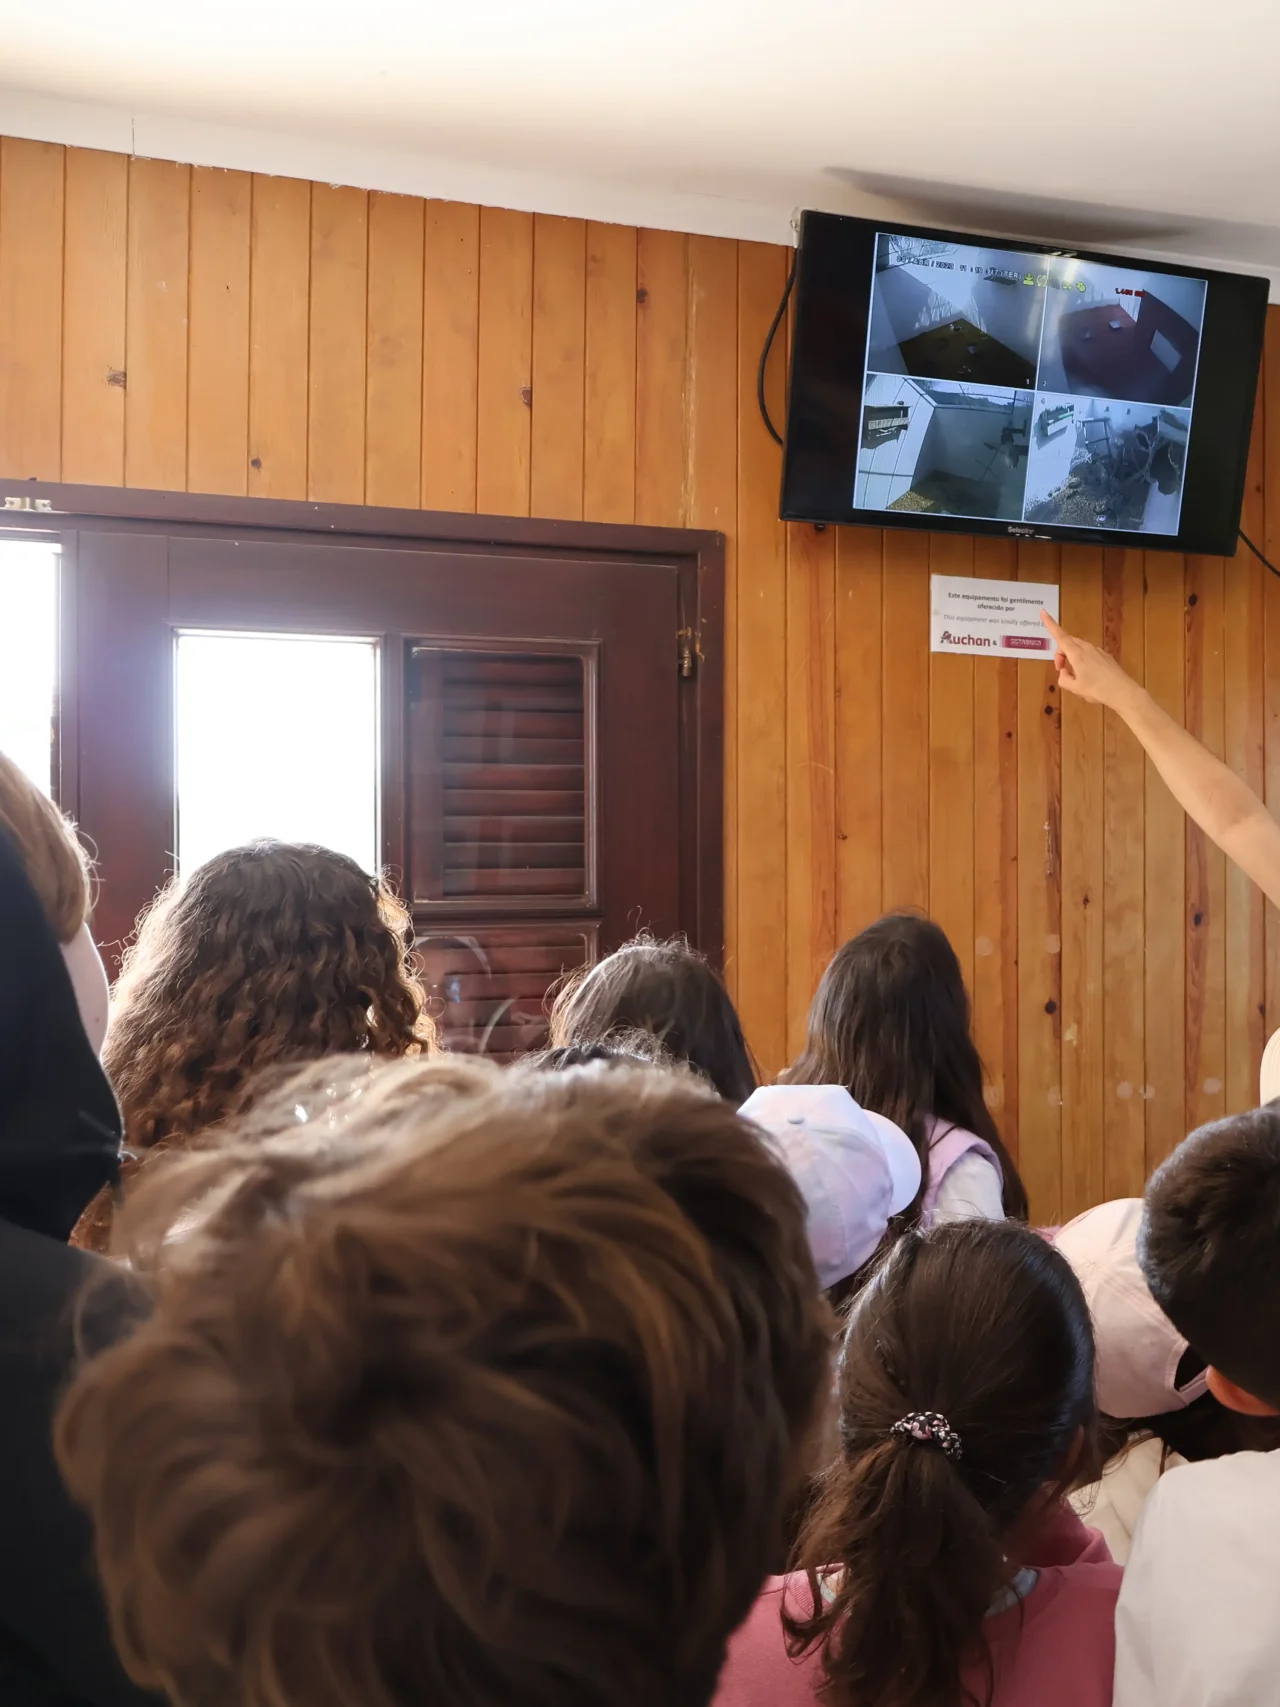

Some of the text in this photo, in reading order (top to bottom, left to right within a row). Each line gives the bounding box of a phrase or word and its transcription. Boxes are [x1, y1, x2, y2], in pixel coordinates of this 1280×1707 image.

[948, 592, 961, 600] Este
[962, 593, 1000, 602] equipamento
[1009, 597, 1044, 605] gentilmente
[977, 603, 1004, 611] oferecido
[956, 615, 988, 624] equipment
[1000, 617, 1018, 626] kindly
[1019, 619, 1040, 627] offered
[940, 630, 991, 647] Auchan
